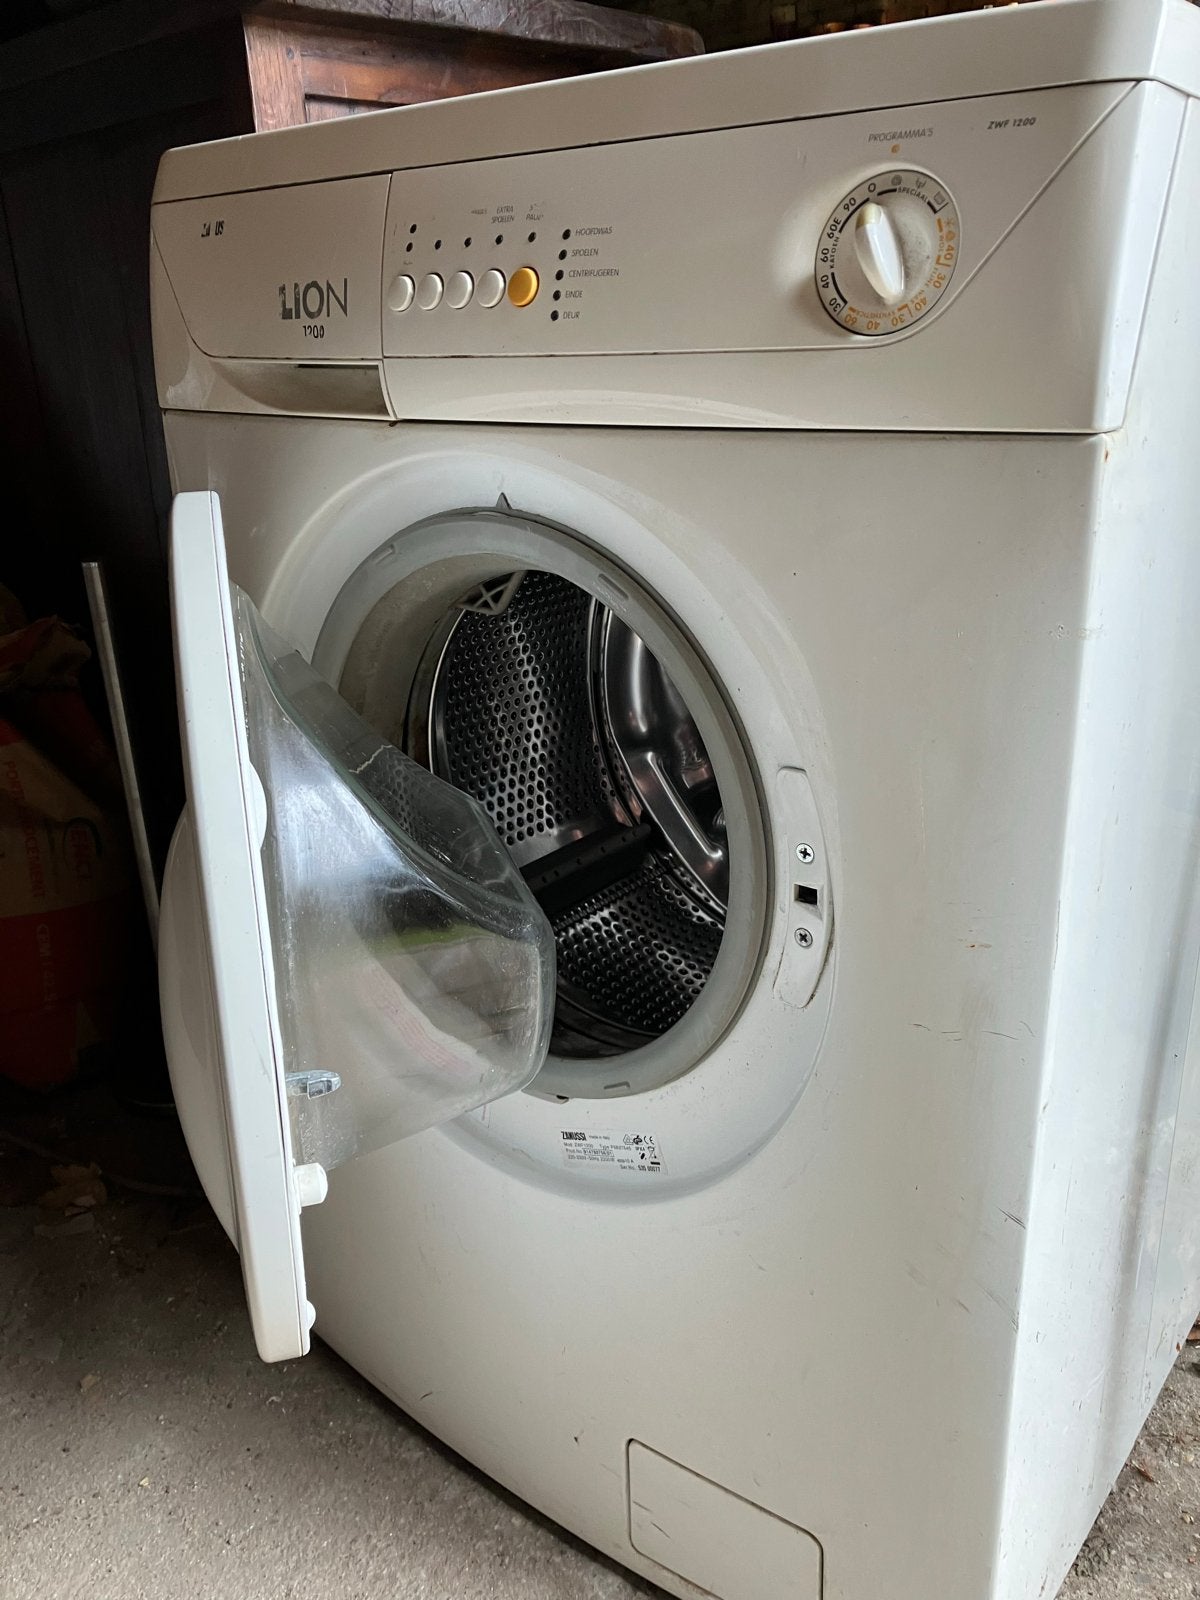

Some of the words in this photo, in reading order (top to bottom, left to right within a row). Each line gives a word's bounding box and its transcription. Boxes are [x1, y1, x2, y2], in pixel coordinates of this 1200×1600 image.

[987, 119, 1009, 130] ZWF
[1012, 116, 1037, 127] 1200
[868, 127, 934, 142] PROGRAMMA'S
[843, 197, 857, 212] 90
[575, 226, 613, 236] HOOFDWAS
[827, 217, 841, 239] 60E
[571, 248, 599, 258] SPOELEN
[820, 248, 829, 263] 60
[830, 237, 840, 268] KATOEN
[943, 244, 954, 260] 40
[568, 268, 619, 278] CENTRIFUGEREN
[820, 275, 829, 289] 40
[933, 273, 946, 288] 30
[279, 278, 348, 320] LION
[565, 290, 583, 298] EINDE
[829, 297, 841, 312] 30
[914, 296, 927, 311] 40
[563, 311, 580, 319] DEUR
[844, 314, 857, 326] 60
[891, 313, 905, 327] 30
[866, 320, 880, 330] 40
[561, 1131, 586, 1141] ZANUSSI
